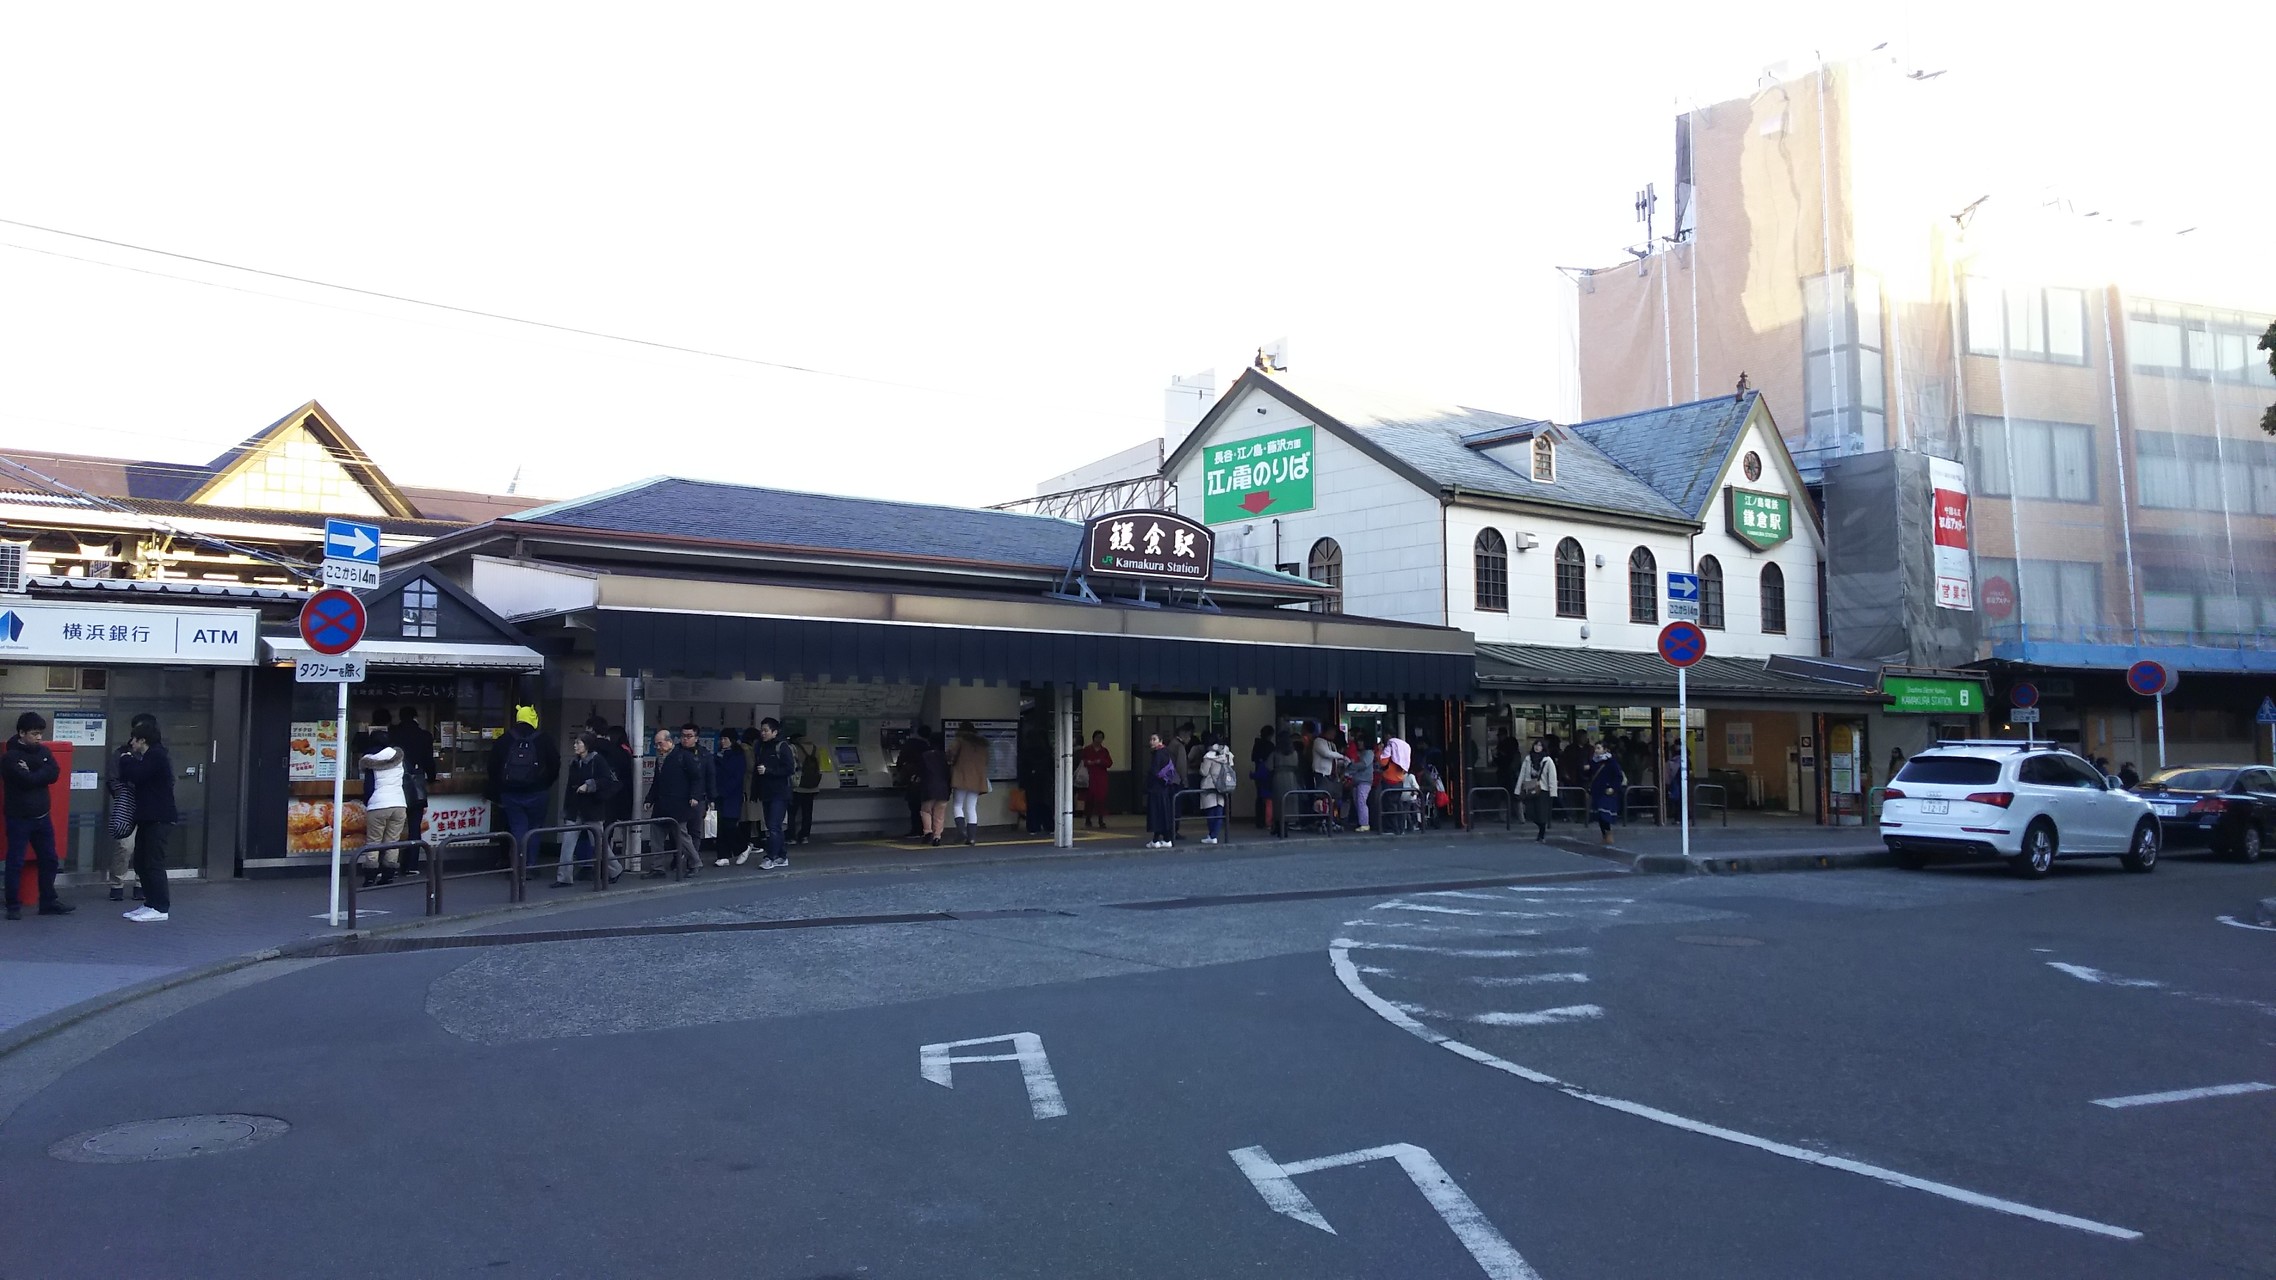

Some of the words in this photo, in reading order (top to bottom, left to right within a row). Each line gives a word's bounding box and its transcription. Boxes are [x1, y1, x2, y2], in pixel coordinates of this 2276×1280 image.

[1207, 451, 1310, 496] 江ノ電のりば
[1743, 509, 1781, 531] 鎌倉駅
[1109, 521, 1195, 558] 鎌倉駅
[1102, 555, 1113, 564] JR
[1116, 557, 1164, 571] Kamakura
[1167, 561, 1199, 574] Station
[326, 565, 376, 585] ここから14m
[63, 622, 150, 643] 横浜銀行
[193, 629, 238, 644] ATM
[300, 663, 361, 677] タクシーを除く
[432, 806, 486, 822] クロワッサン
[438, 818, 482, 832] 生地使用!
